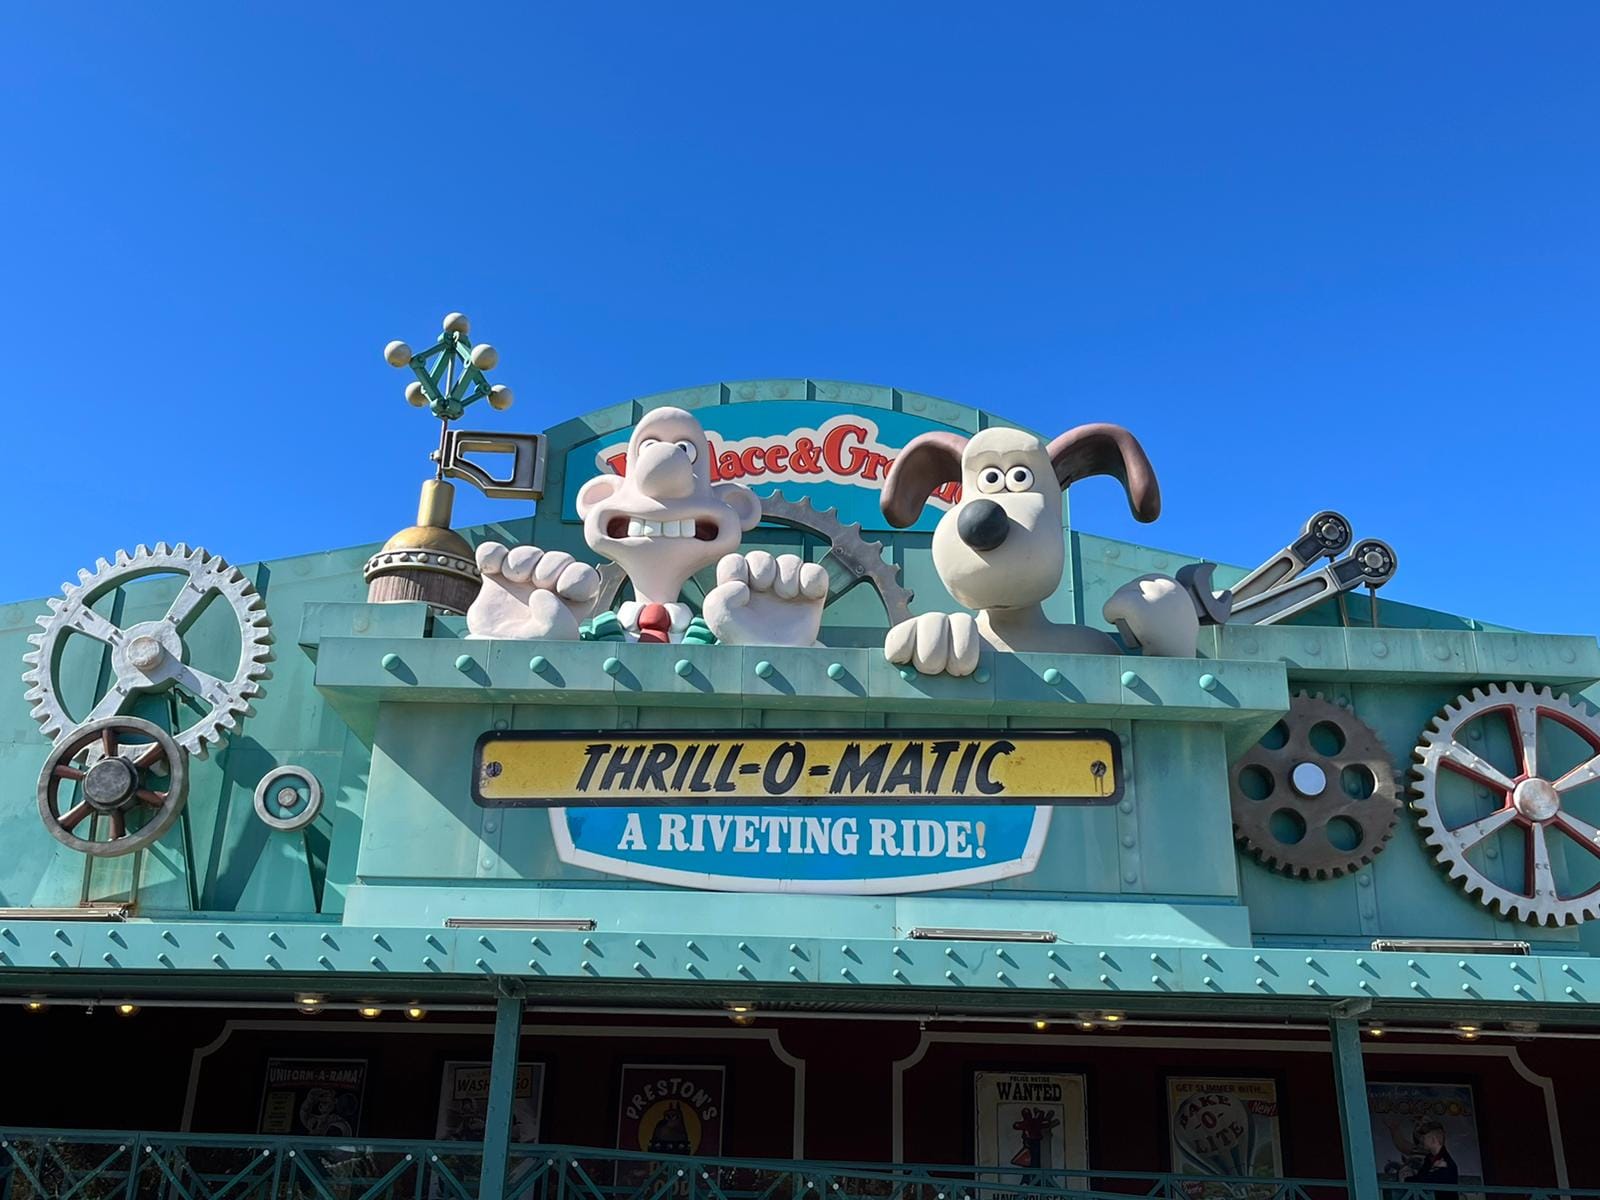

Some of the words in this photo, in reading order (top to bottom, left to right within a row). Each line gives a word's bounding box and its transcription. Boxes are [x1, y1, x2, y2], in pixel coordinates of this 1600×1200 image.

[575, 740, 1016, 796] THRILL-O-MATIC
[617, 812, 648, 850] A
[657, 813, 860, 856] RIVETING
[867, 817, 988, 860] RIDE!
[626, 1078, 718, 1120] PRESTON'S
[996, 1082, 1062, 1102] WANTED
[1175, 1083, 1192, 1092] GET
[1193, 1120, 1245, 1154] LITE
